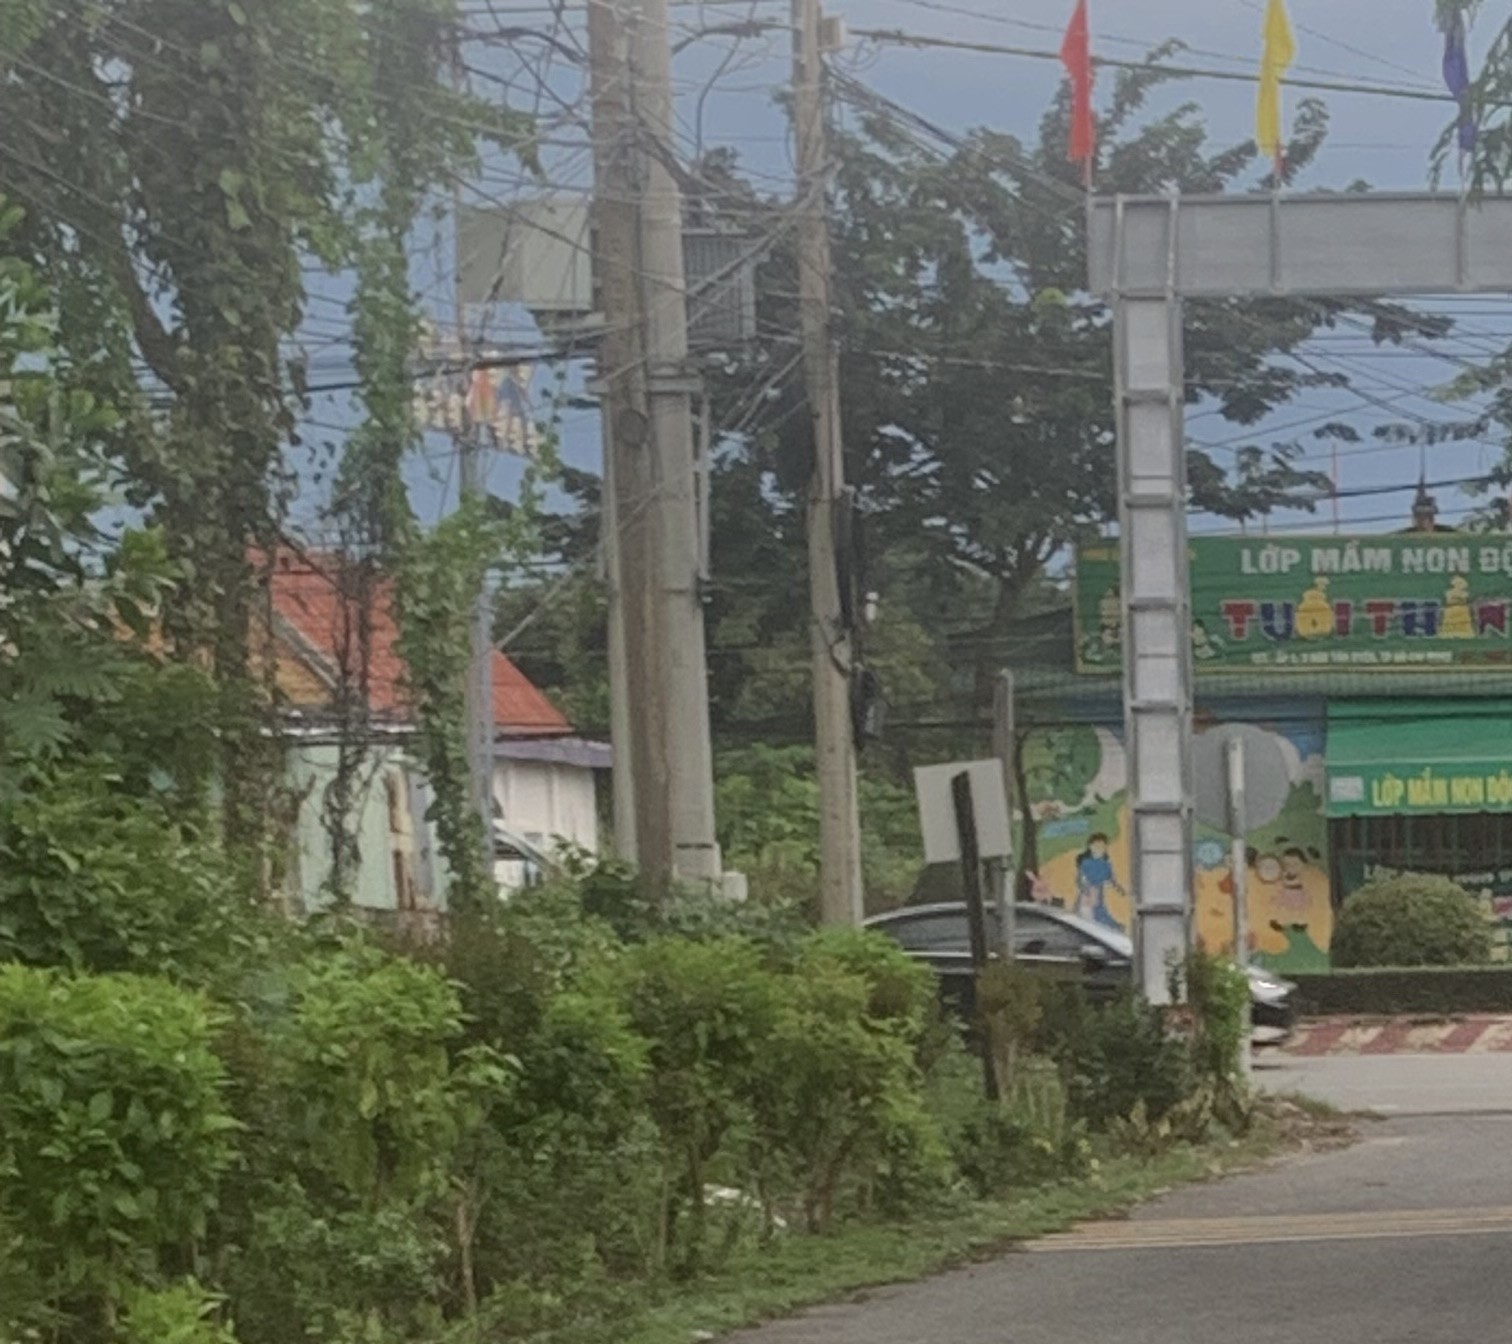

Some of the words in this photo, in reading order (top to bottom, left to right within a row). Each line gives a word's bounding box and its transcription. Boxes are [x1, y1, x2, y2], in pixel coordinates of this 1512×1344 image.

[1241, 543, 1300, 574] LỚP
[1311, 539, 1393, 573] MẦM
[1402, 547, 1471, 573] NON
